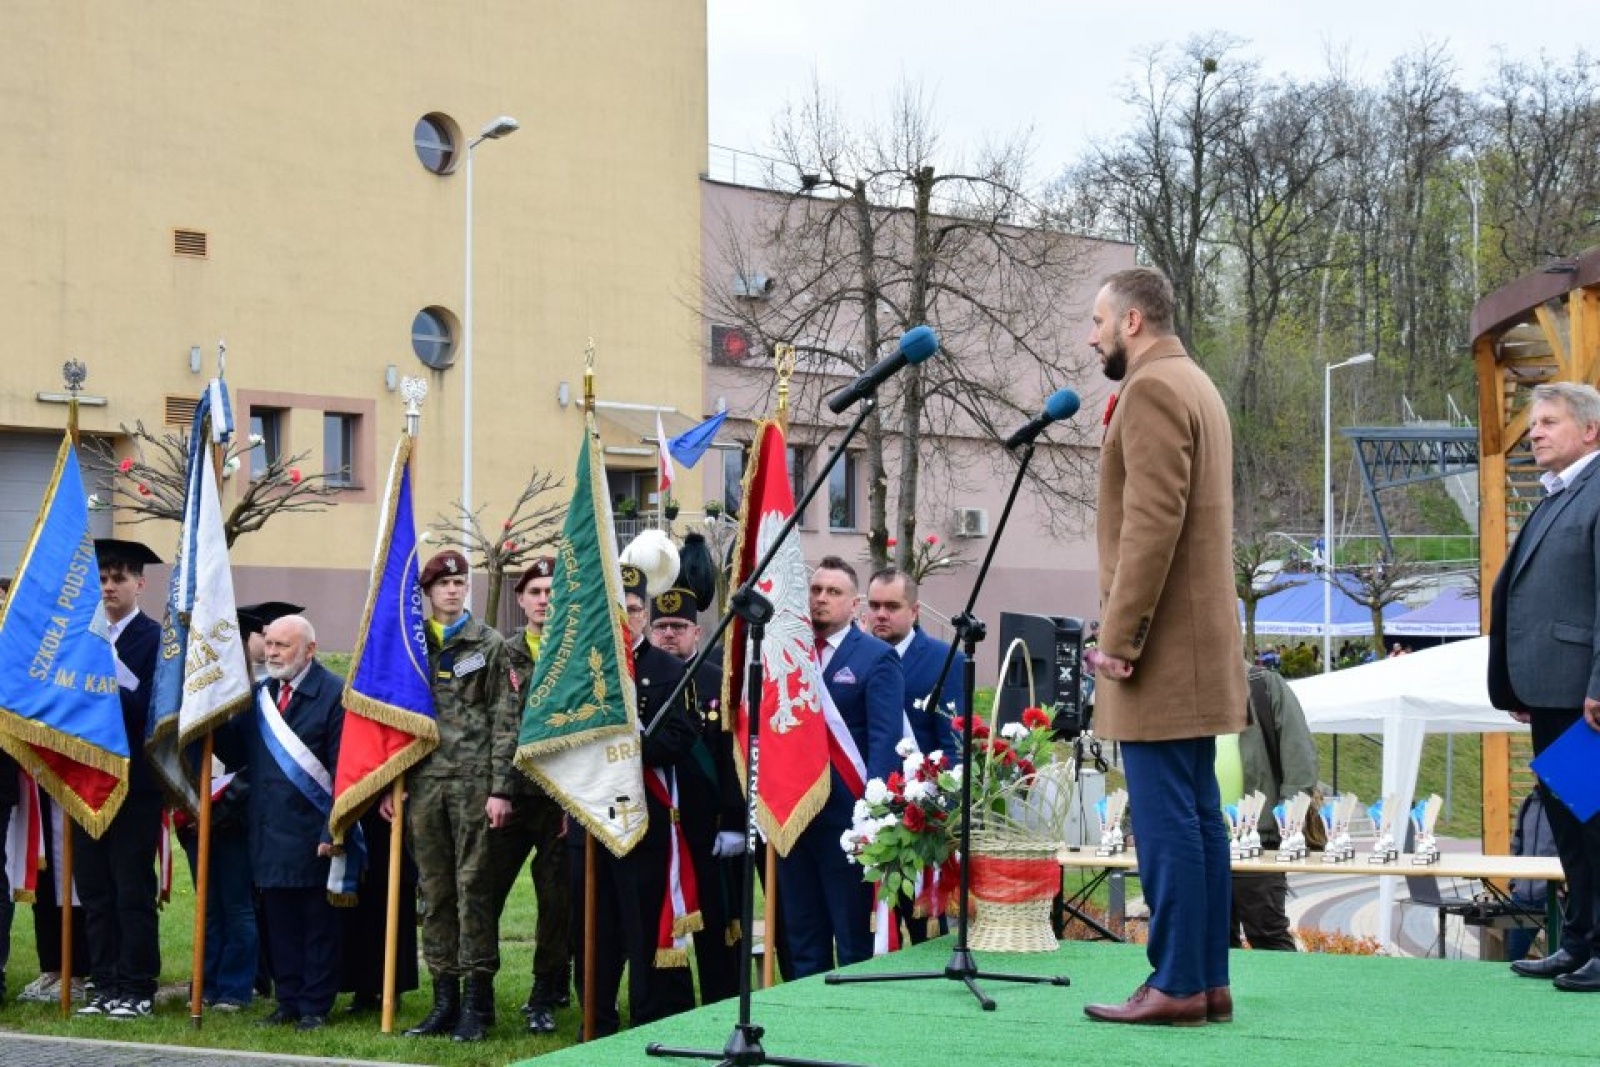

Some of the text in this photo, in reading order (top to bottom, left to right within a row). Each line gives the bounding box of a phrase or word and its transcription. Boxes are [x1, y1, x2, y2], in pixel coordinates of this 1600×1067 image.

[29, 615, 70, 681] SZKOŁA
[54, 667, 77, 690] IM.
[530, 603, 581, 708] KAMIENNEGO
